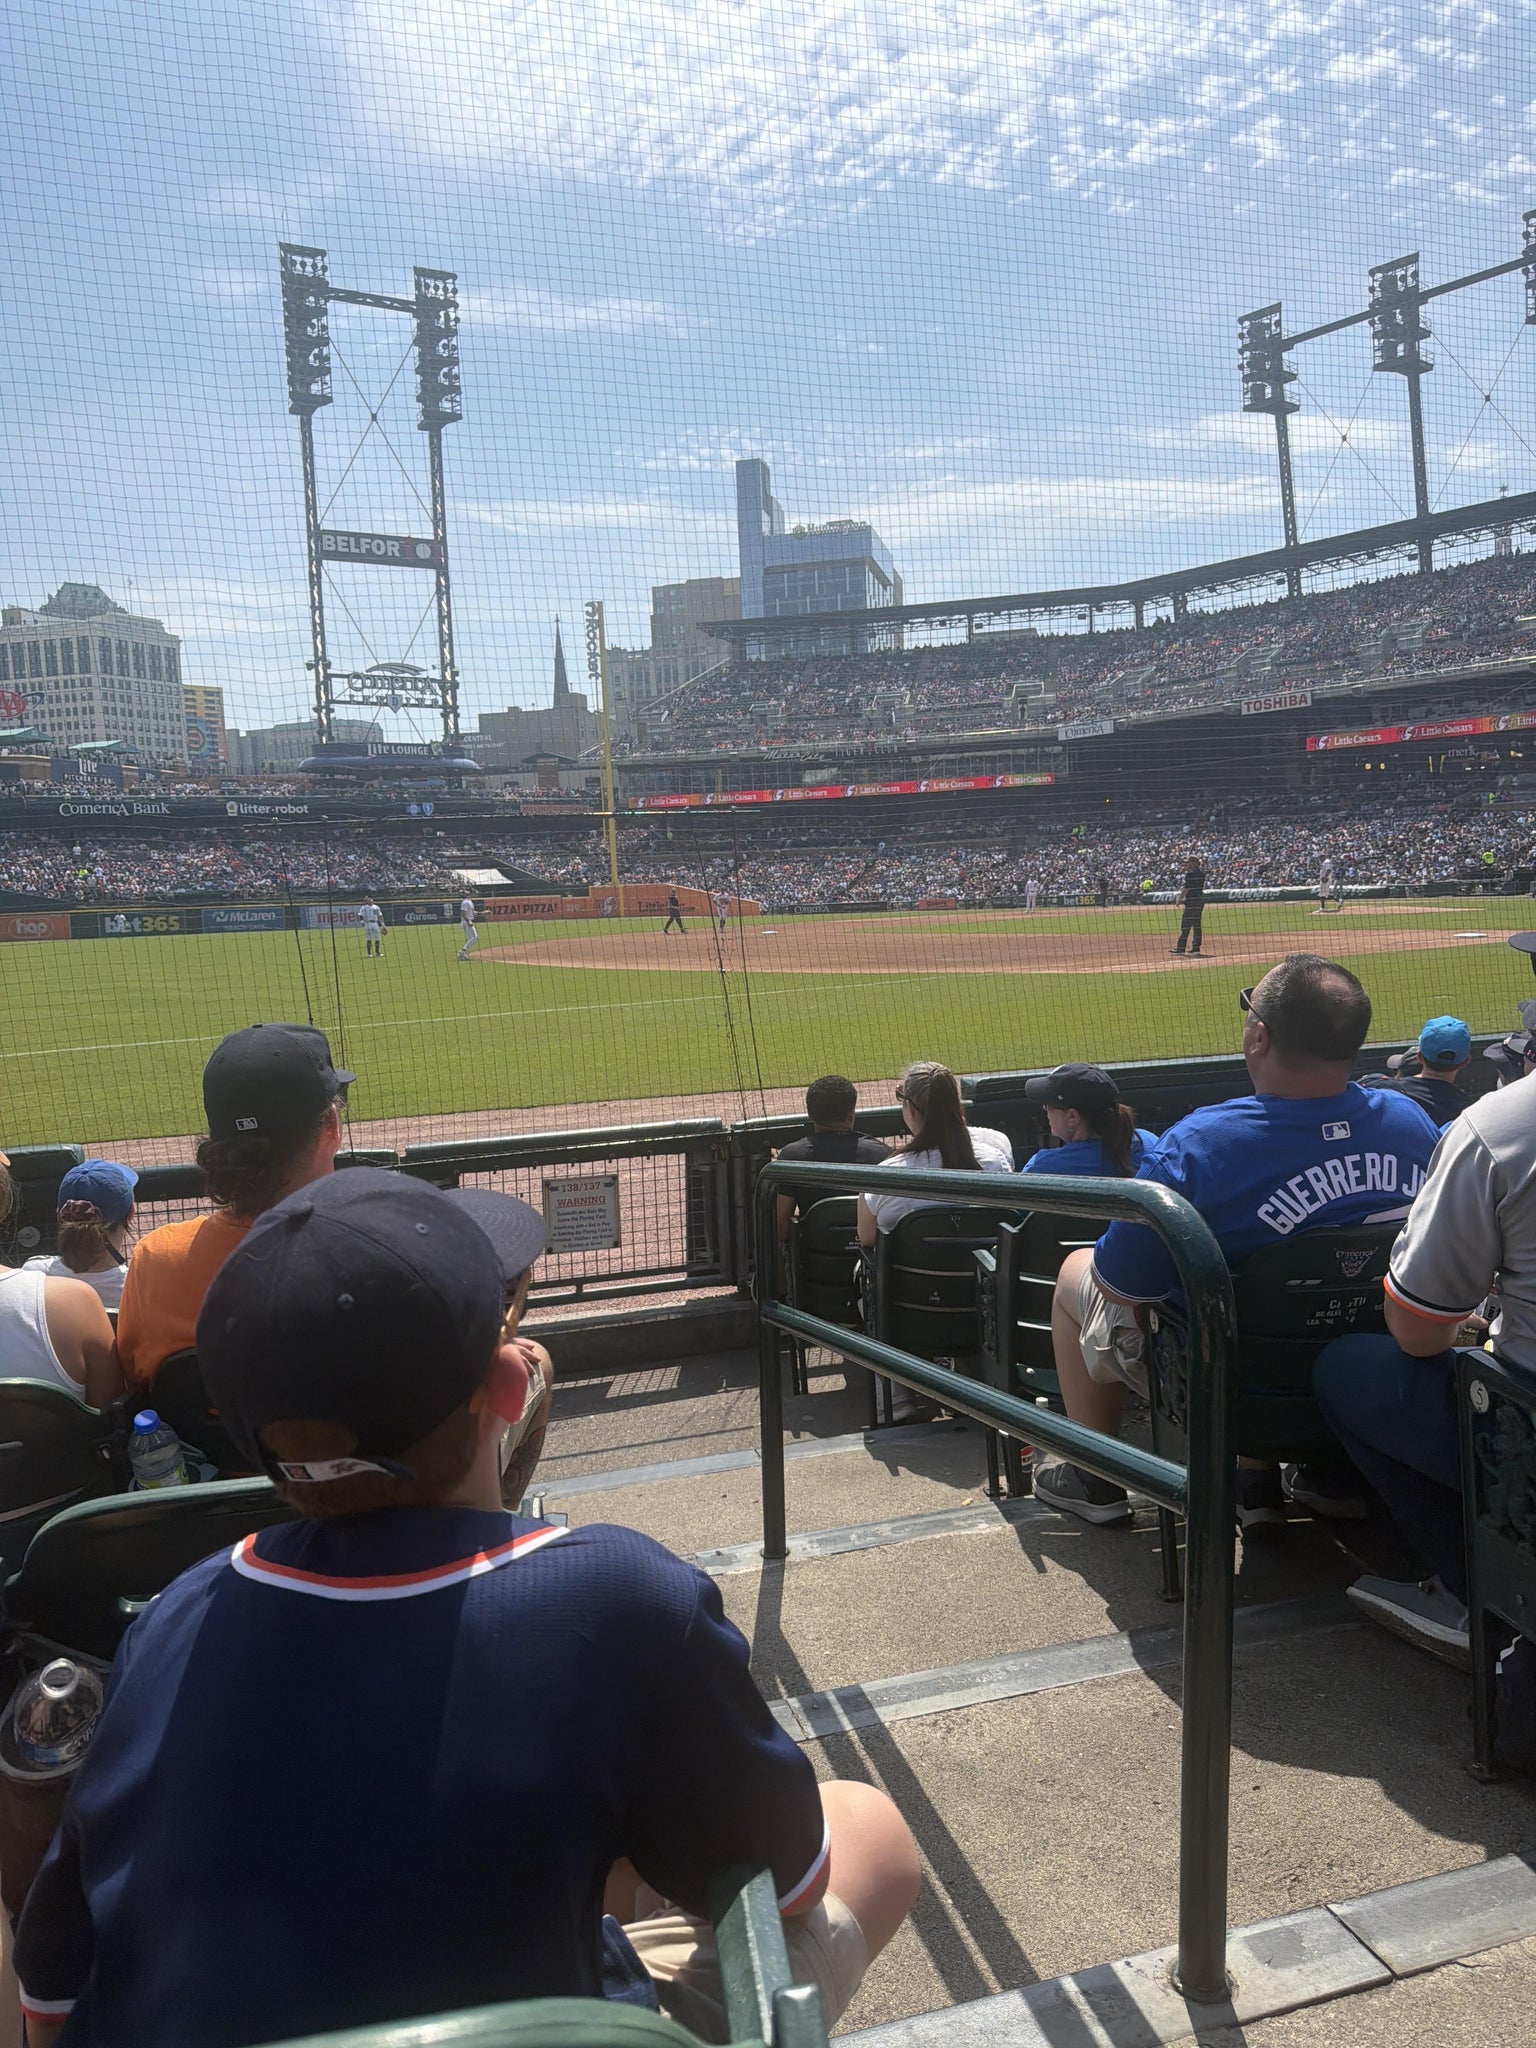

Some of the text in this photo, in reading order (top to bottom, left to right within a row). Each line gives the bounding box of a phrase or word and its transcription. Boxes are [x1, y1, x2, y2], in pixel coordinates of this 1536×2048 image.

[322, 534, 401, 557] BELFOR
[1243, 693, 1309, 713] TOSHIBA
[1421, 724, 1473, 737] Little Caesars
[1334, 734, 1382, 746] Little Caesars
[391, 746, 429, 755] LOUNGE
[835, 746, 864, 756] TIGER
[79, 757, 98, 775] Lite
[133, 803, 170, 814] Bank
[1063, 895, 1096, 906] bet365
[486, 903, 521, 915] PIZZA!
[523, 903, 558, 914] PIZZA!
[229, 910, 275, 922] McLaren
[405, 912, 437, 923] Corona
[15, 918, 48, 936] hap
[561, 1181, 601, 1193] 138/137
[1257, 1152, 1398, 1235] GUERRERO
[557, 1195, 606, 1206] WARNING
